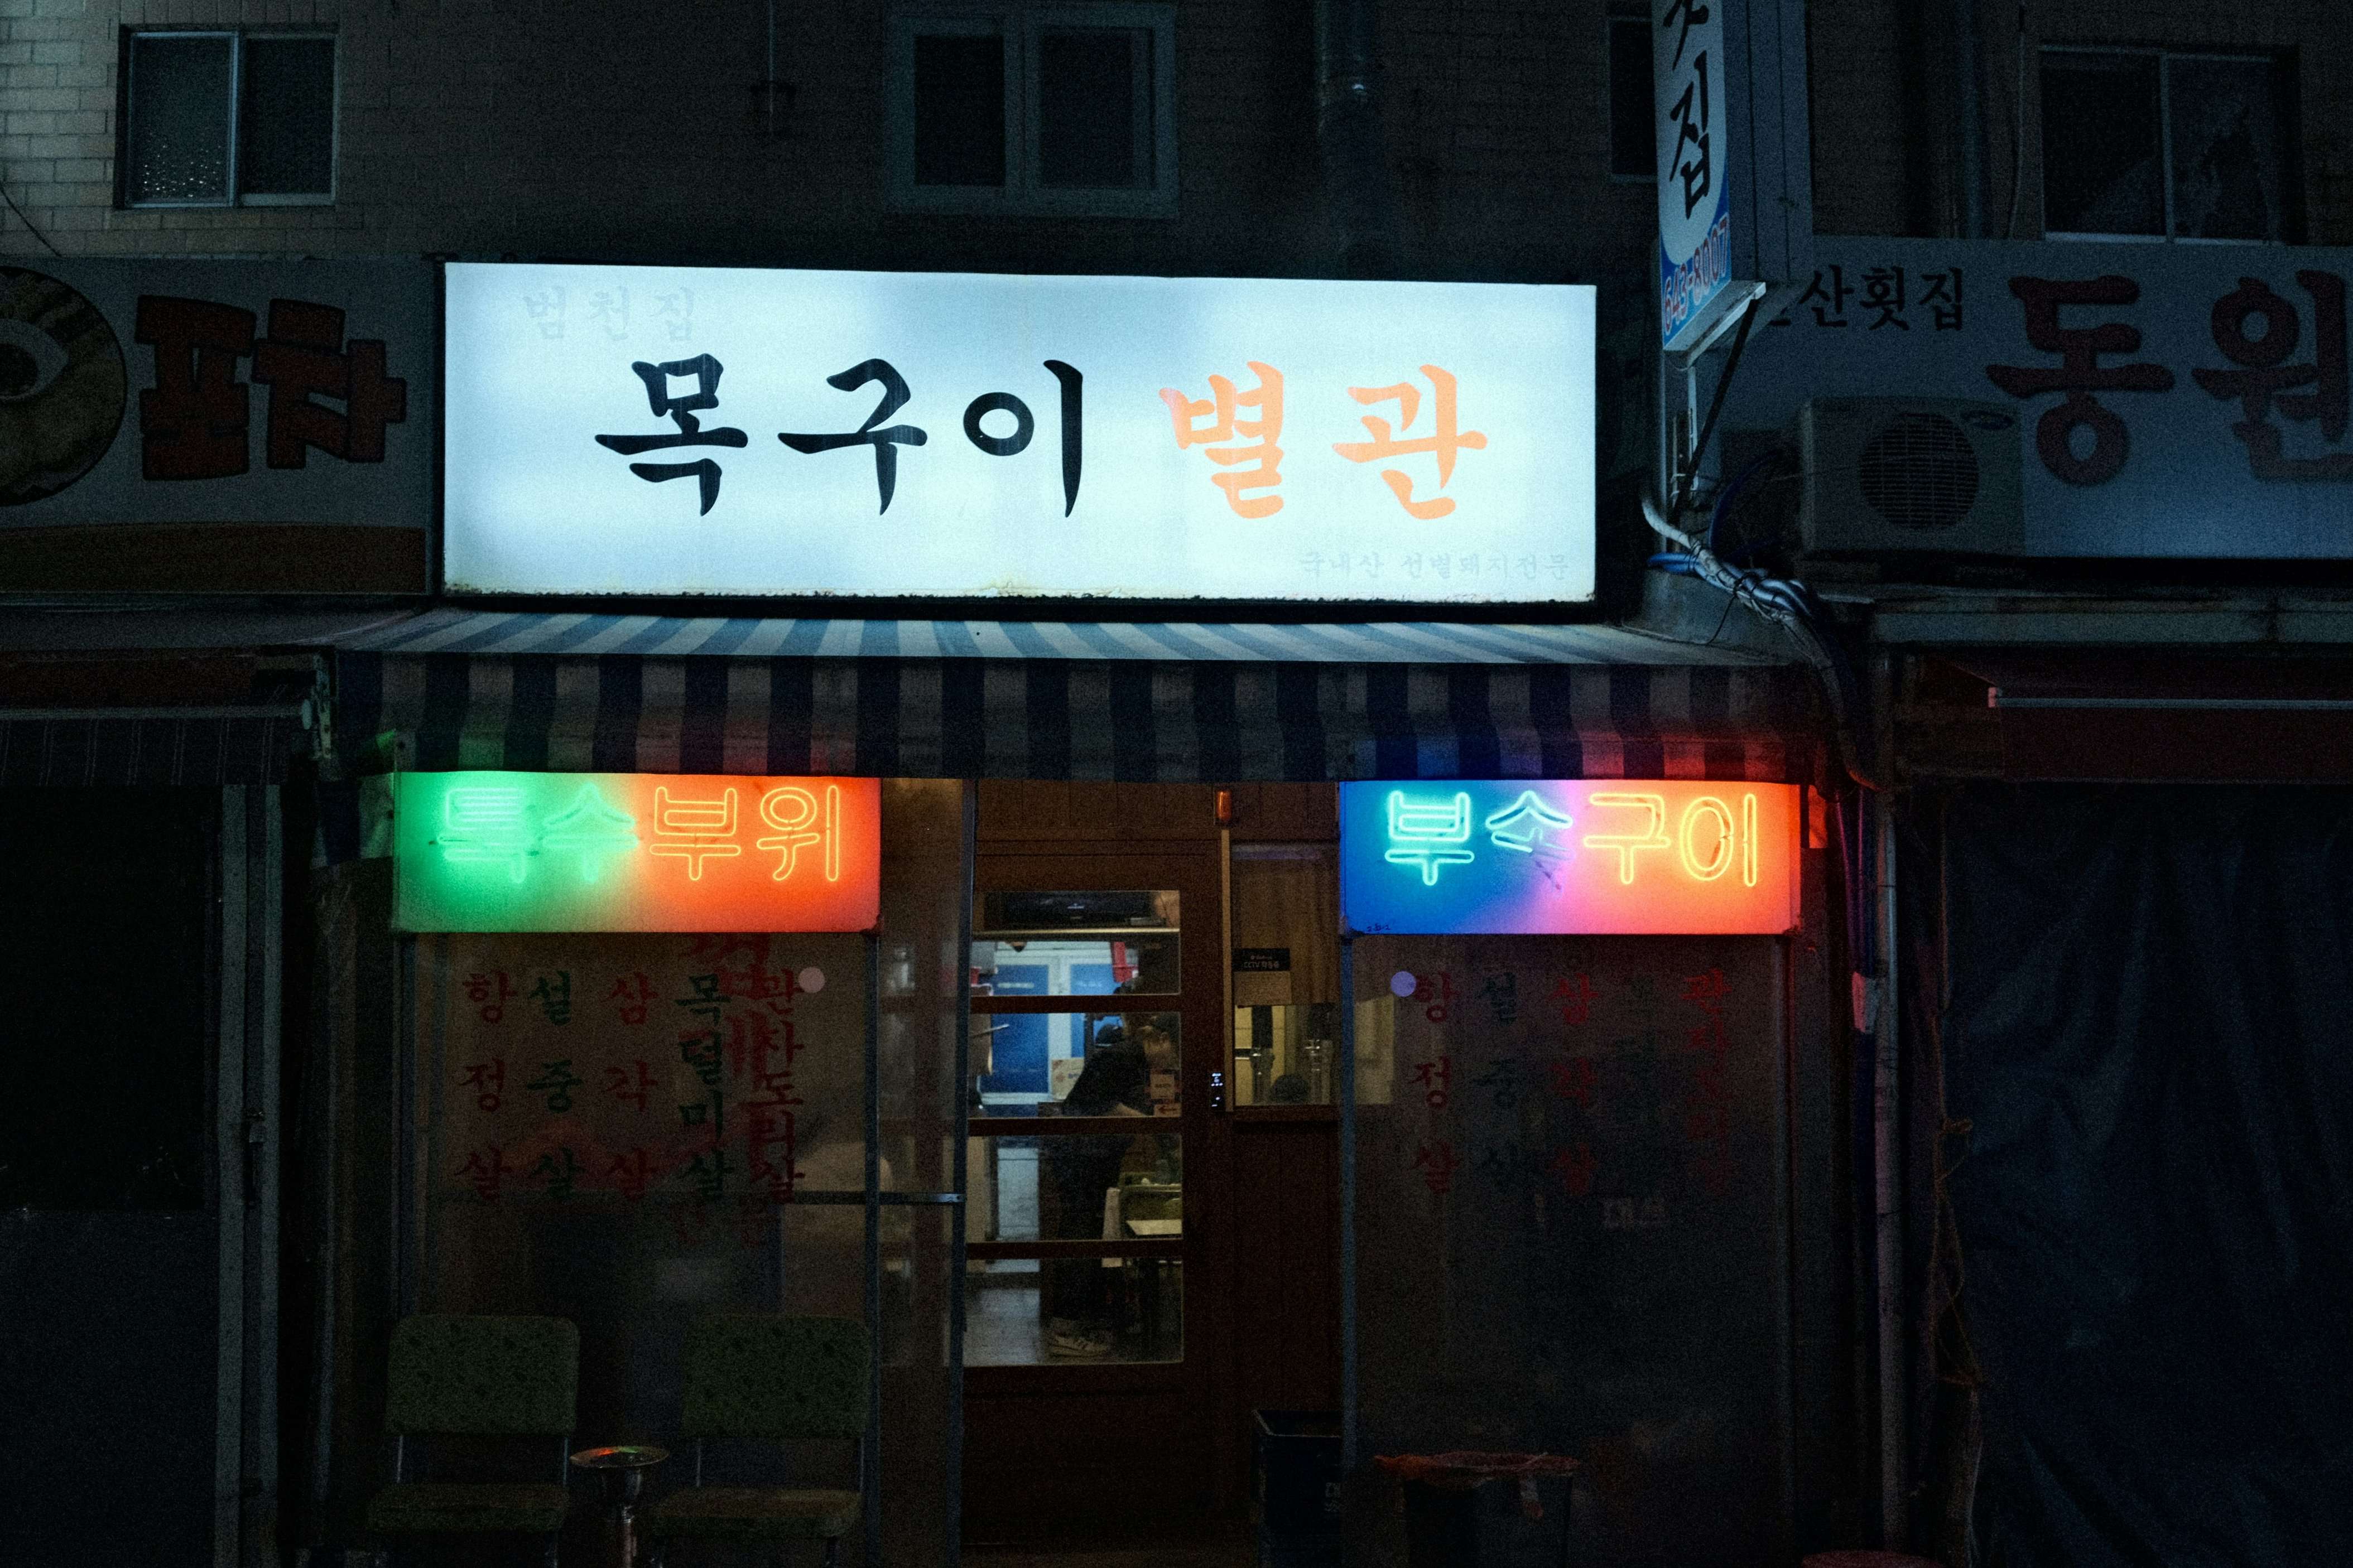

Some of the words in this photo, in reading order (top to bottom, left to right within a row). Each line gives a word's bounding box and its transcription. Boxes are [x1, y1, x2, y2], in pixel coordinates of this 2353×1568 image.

[1663, 213, 1730, 335] 643-8007
[1769, 264, 1963, 332] 산횟집
[136, 295, 406, 481] 포차
[595, 353, 1082, 517] 목구이
[1159, 361, 1488, 519] 별관
[1986, 269, 2353, 486] 동원
[436, 782, 840, 883] 특수부위
